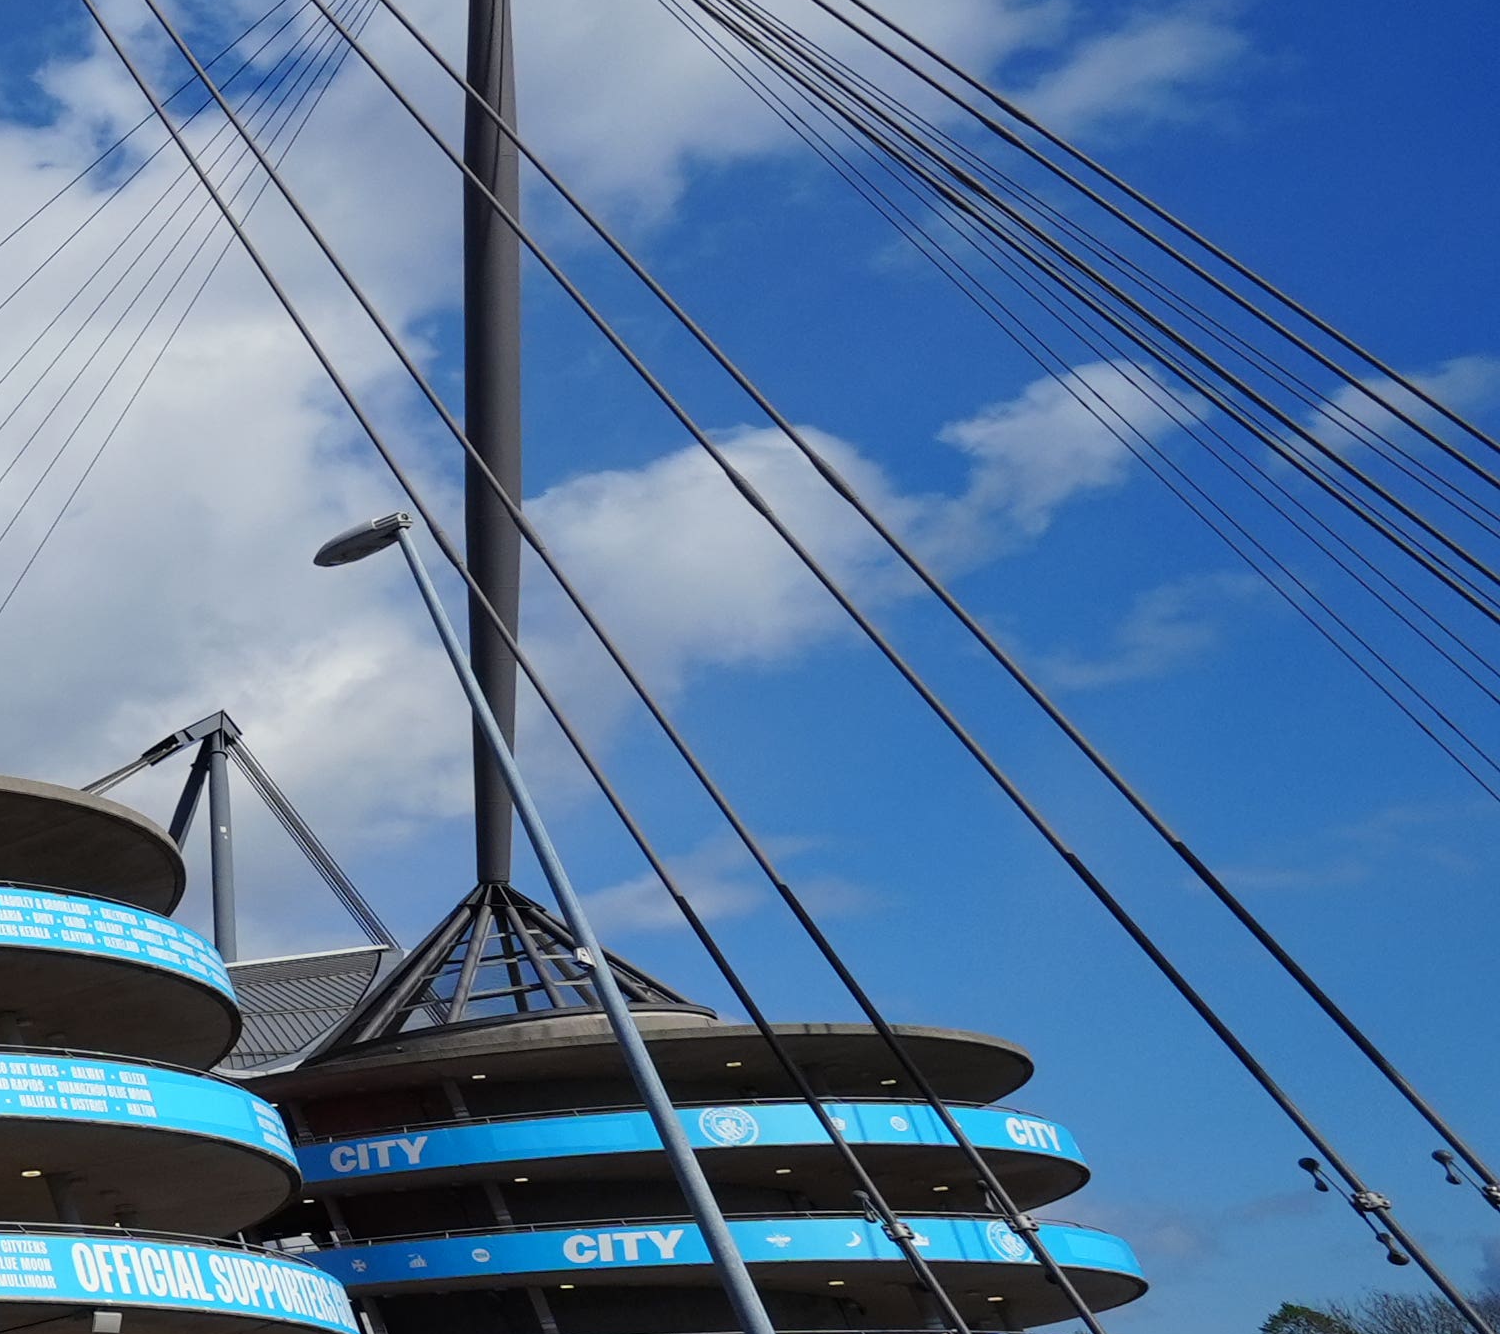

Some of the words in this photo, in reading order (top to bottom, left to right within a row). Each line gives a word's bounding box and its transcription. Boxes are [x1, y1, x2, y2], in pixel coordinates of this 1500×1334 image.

[1006, 1117, 1062, 1152] CITY
[329, 1136, 428, 1173] CITY
[562, 1229, 684, 1263] CITY
[71, 1242, 215, 1301] OFFICIAL
[208, 1253, 335, 1324] SUPPORTERS
